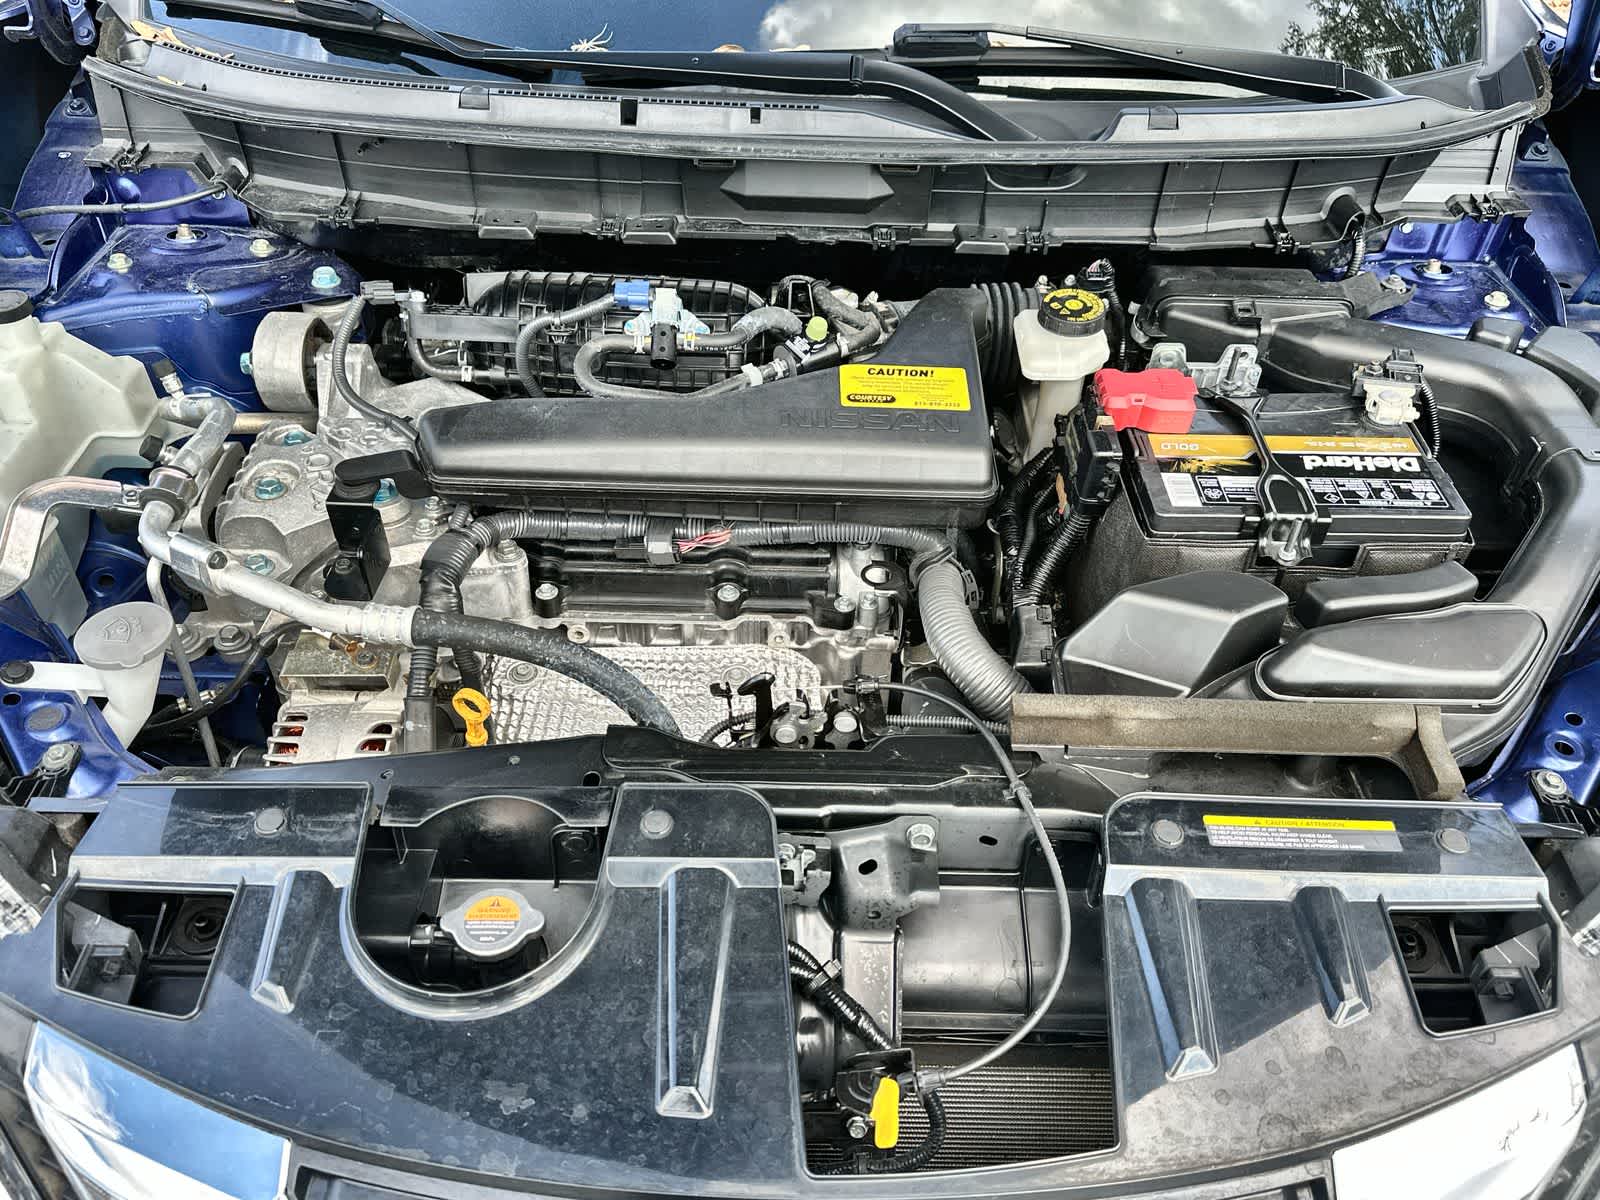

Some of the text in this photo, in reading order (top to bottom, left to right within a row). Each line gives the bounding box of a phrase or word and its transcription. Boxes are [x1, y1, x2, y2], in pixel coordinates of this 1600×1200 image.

[867, 367, 935, 378] CAUTION!
[849, 393, 893, 402] COURTESY
[780, 411, 961, 433] NISSAN
[1161, 441, 1200, 451] GOLD
[1302, 455, 1421, 473] DieHard
